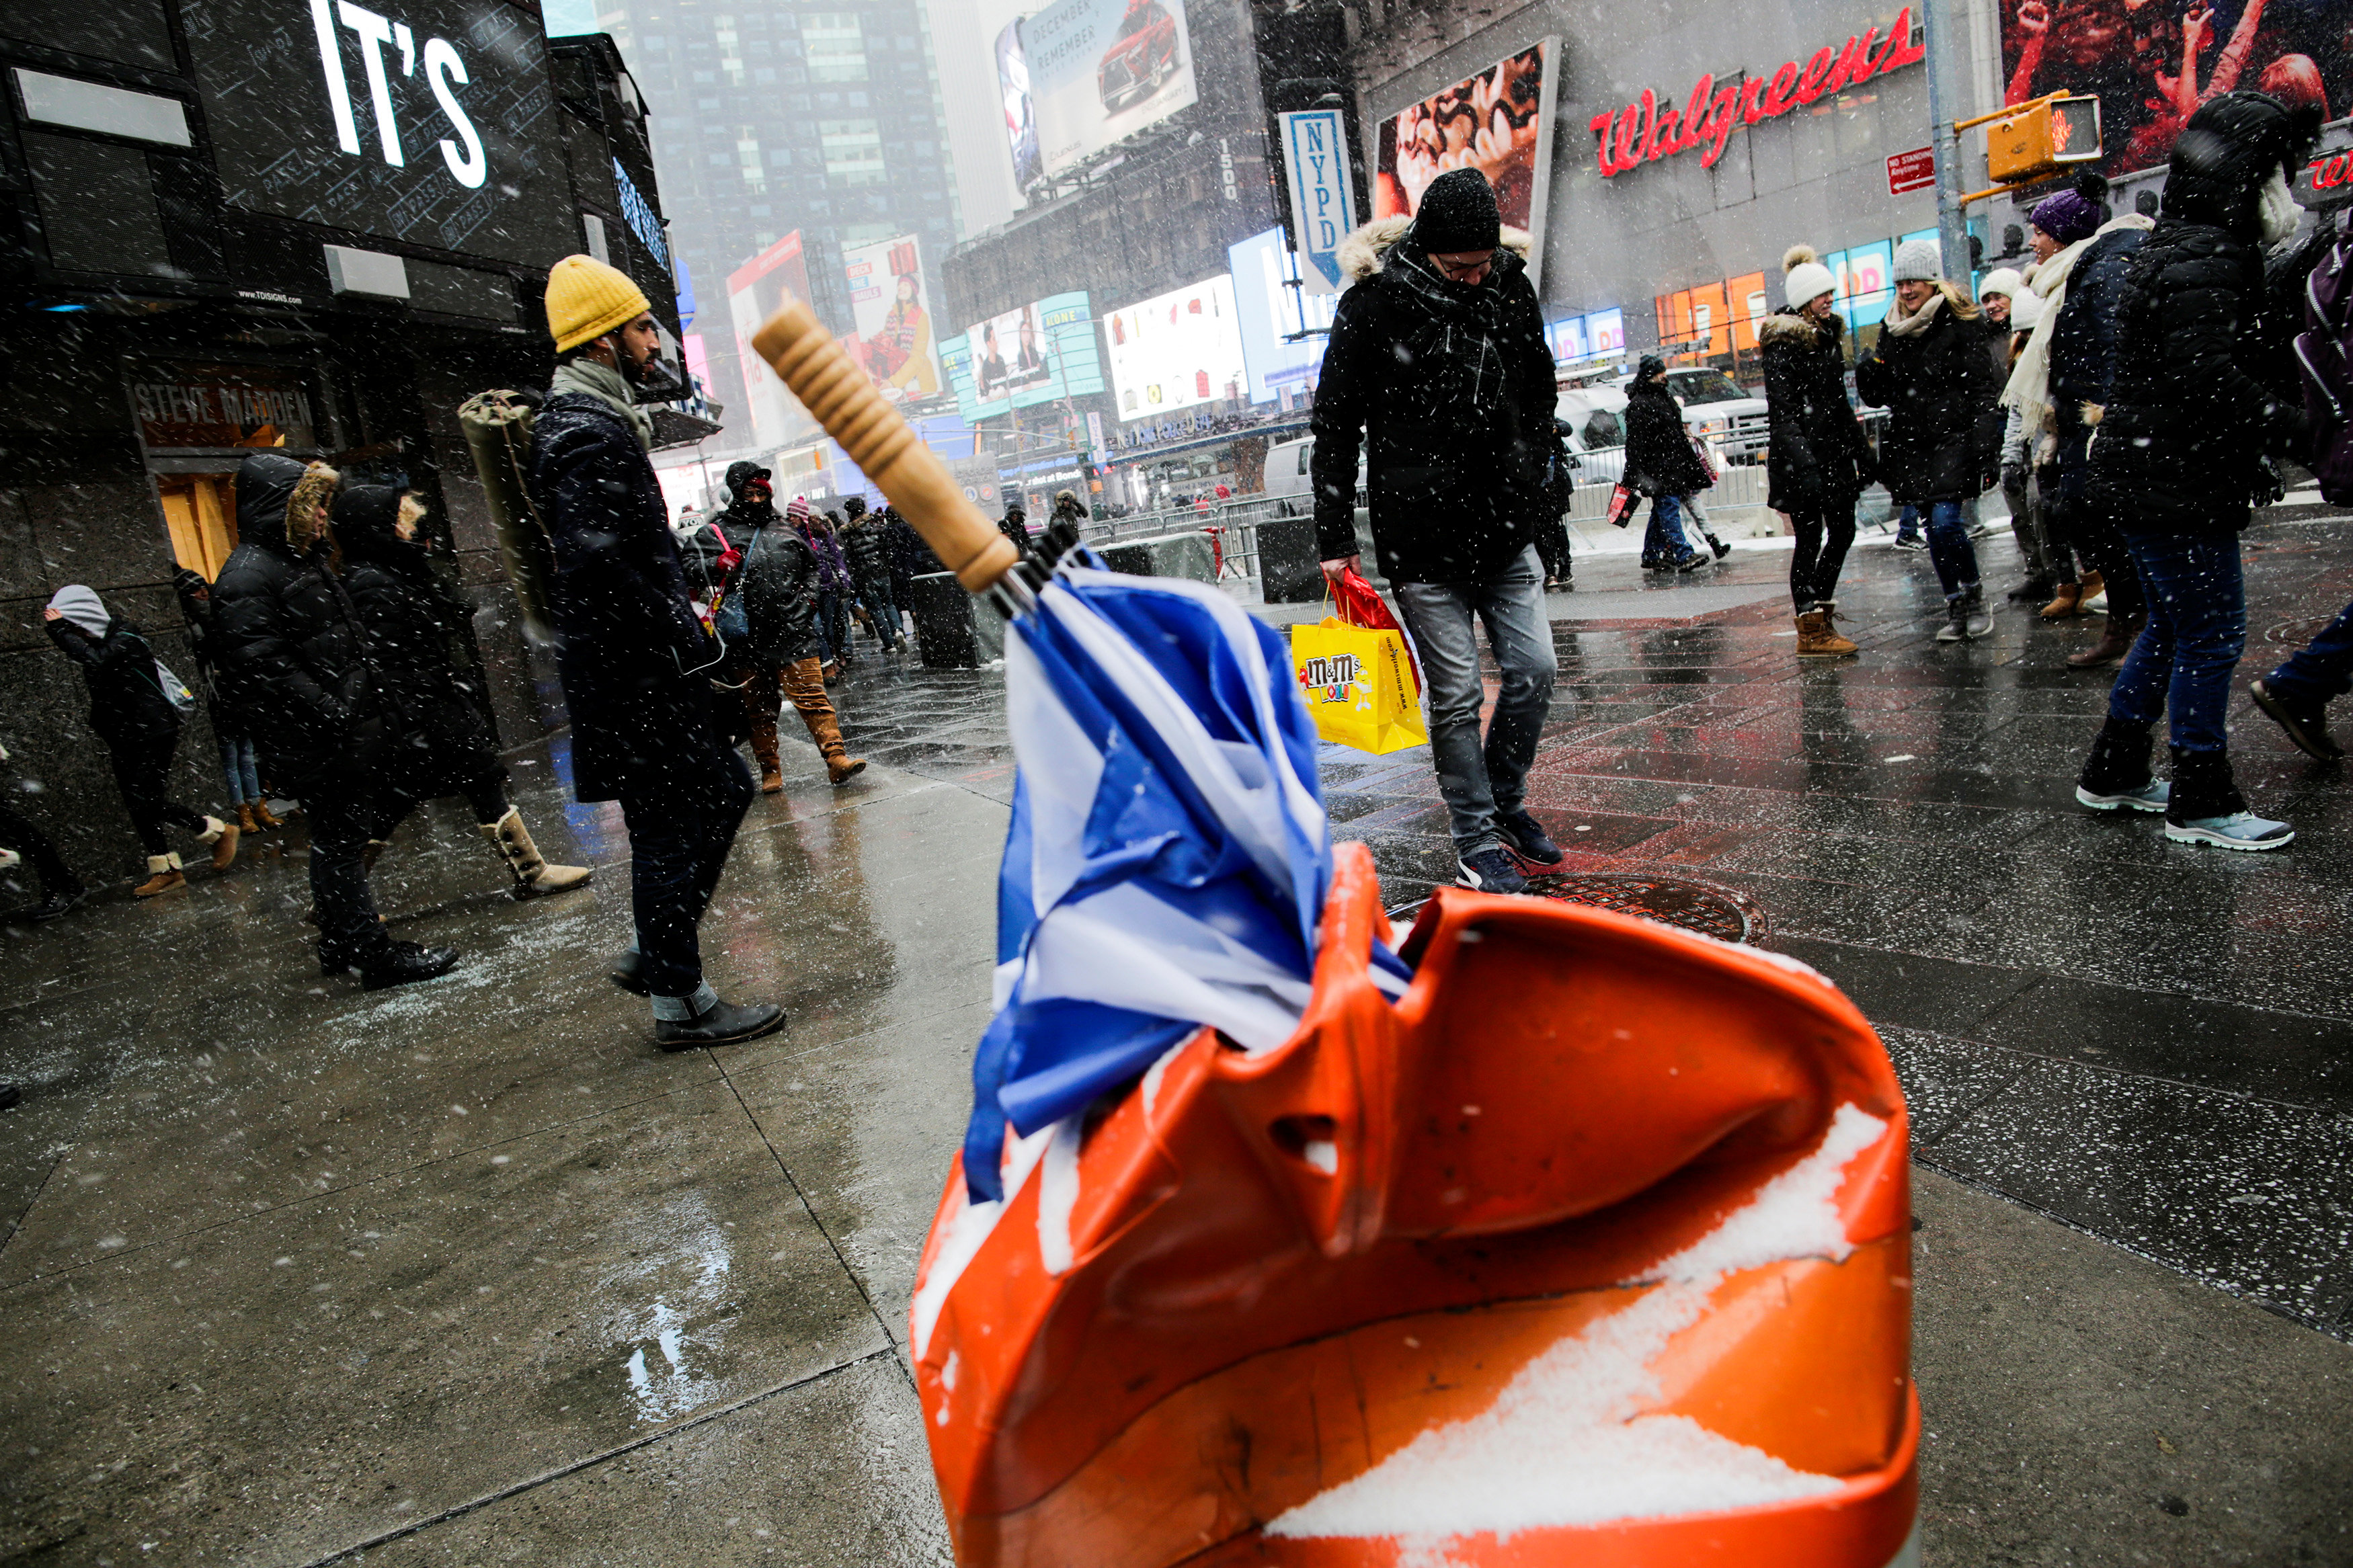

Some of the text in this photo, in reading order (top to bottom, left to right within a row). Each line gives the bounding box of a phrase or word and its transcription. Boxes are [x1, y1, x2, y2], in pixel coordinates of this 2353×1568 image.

[1033, 0, 1092, 45] DECEMBER
[1036, 24, 1096, 70] REMEMBER
[309, 0, 487, 190] IT'S
[1589, 7, 1925, 177] Walgreens
[1220, 137, 1237, 200] 1500
[1888, 158, 1900, 167] NO
[405, 183, 439, 214] PASS
[1305, 122, 1336, 249] NYPD
[455, 199, 488, 229] PASS
[850, 263, 870, 276] DECK
[851, 278, 867, 288] THE
[238, 290, 303, 304] www.TDISIGNS.com
[854, 288, 879, 302] HAULS
[1045, 311, 1077, 327] ALONE
[134, 383, 314, 427] STEVE MADDEN
[1090, 413, 1103, 462] NYPD
[1386, 636, 1408, 710] www.mmsworld.com
